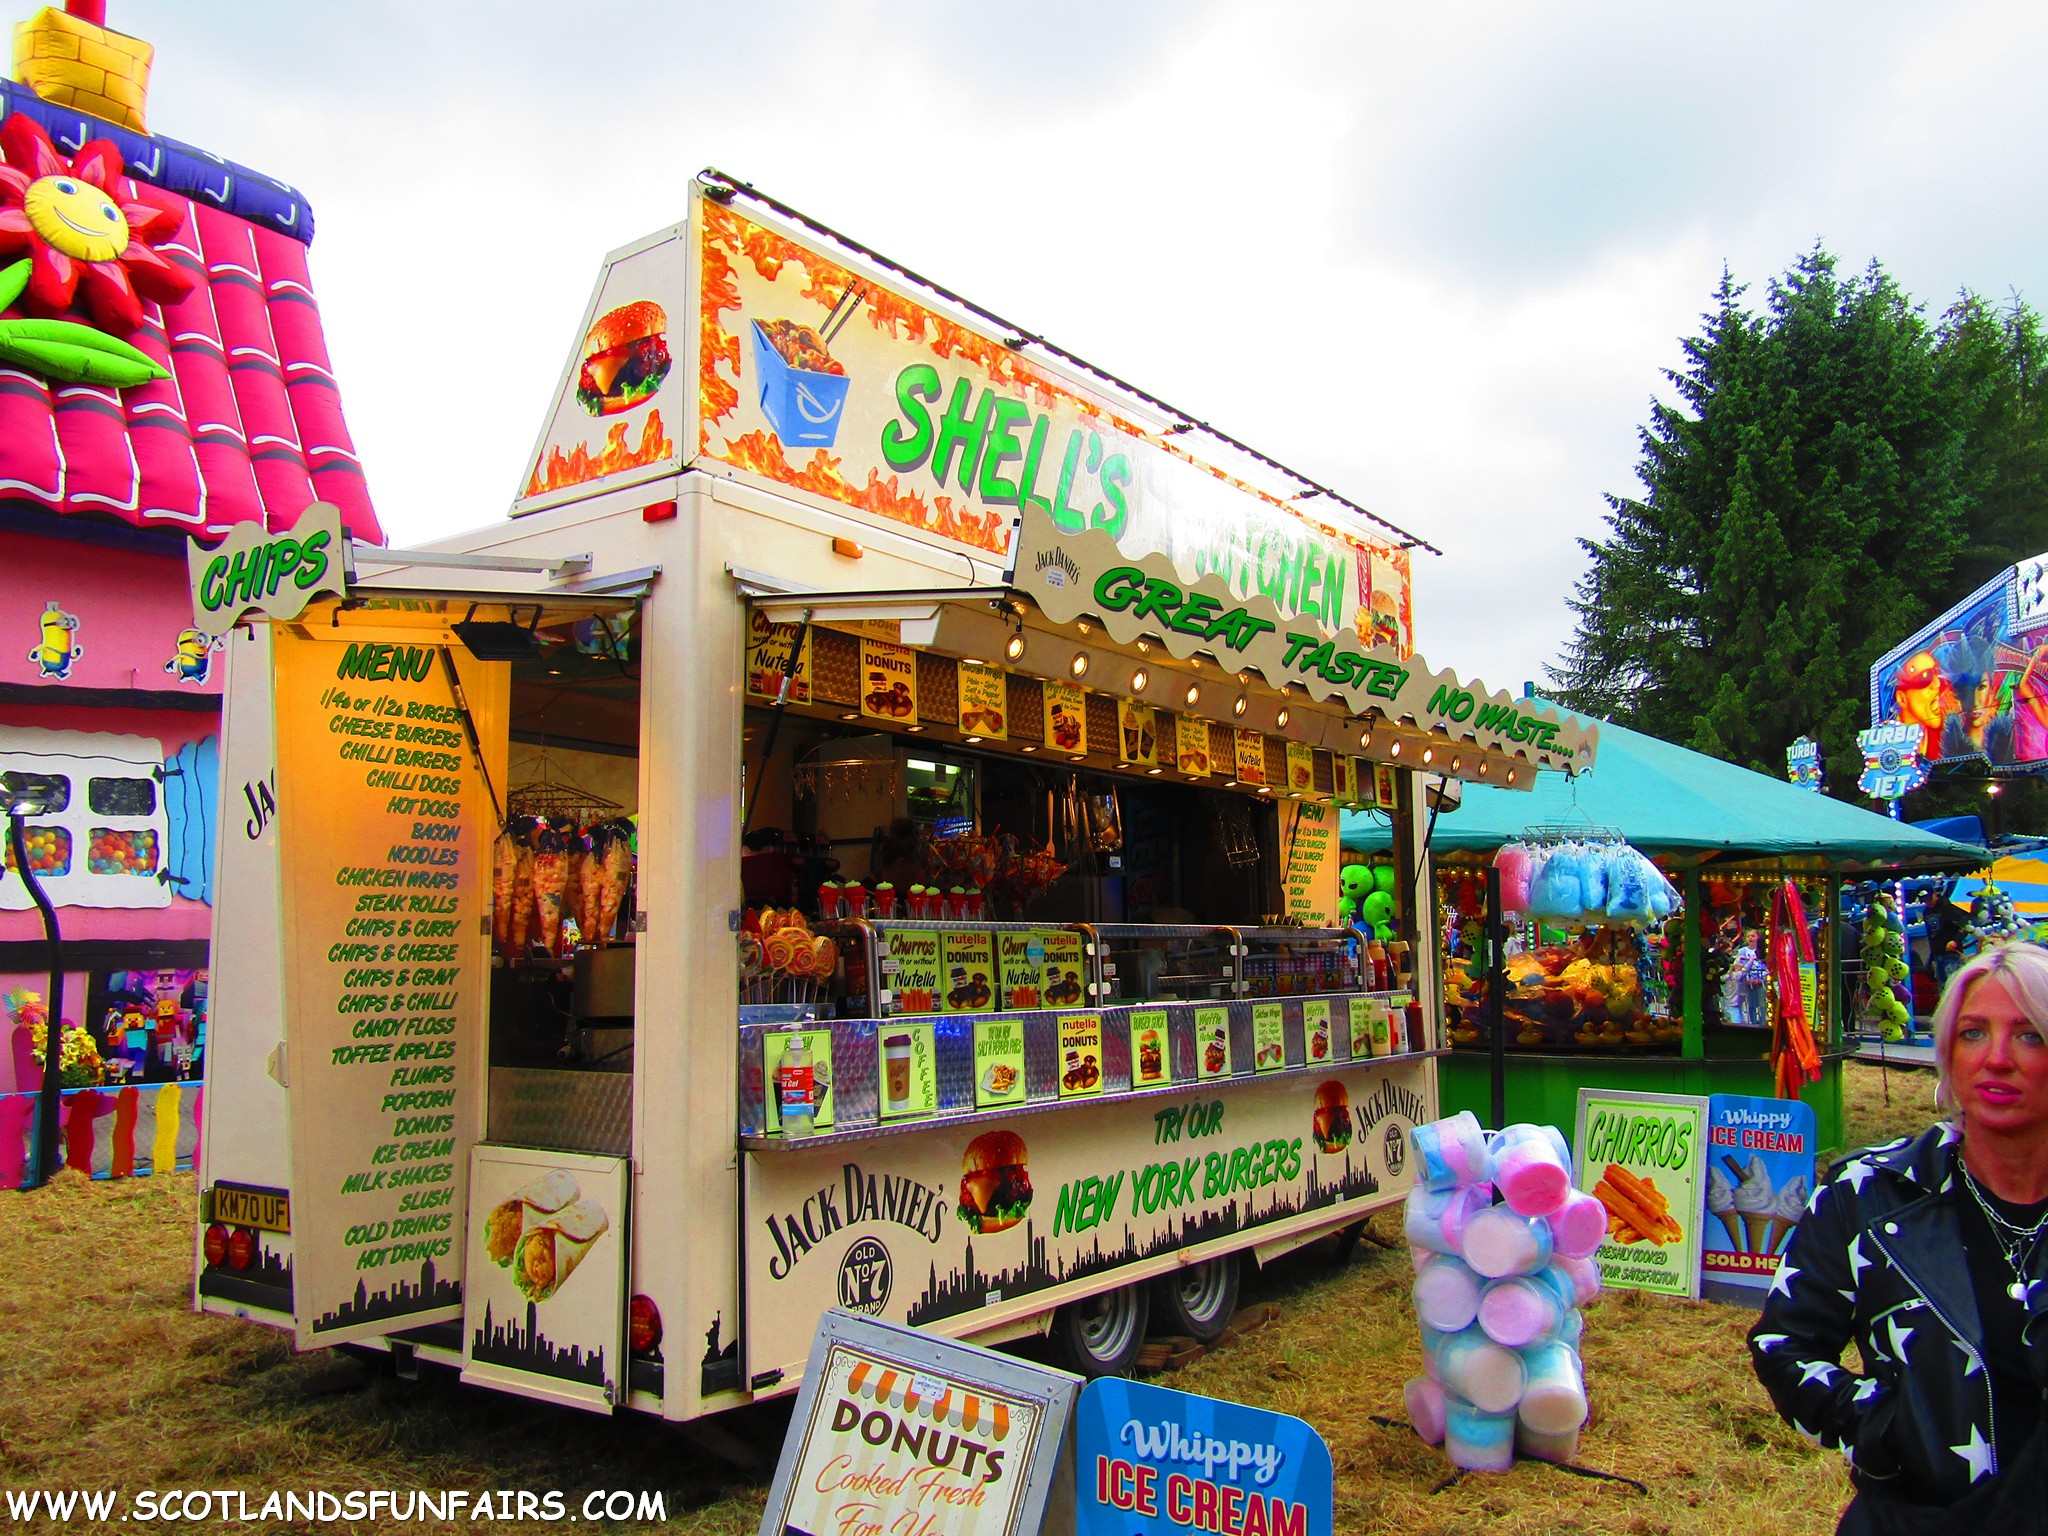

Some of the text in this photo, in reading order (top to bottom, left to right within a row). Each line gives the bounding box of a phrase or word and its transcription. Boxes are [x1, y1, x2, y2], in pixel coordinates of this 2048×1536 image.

[881, 363, 1132, 544] SHELL'S
[201, 530, 331, 611] CHIPS
[1036, 550, 1055, 572] JACK
[1055, 546, 1081, 585] DANIEL'S
[1093, 567, 1275, 653] GREAT
[1282, 632, 1410, 701] TASTE!
[1427, 684, 1475, 722] NO
[337, 643, 436, 682] MENU
[755, 648, 804, 674] Nutea
[865, 653, 912, 675] DONUTS
[354, 698, 371, 711] or
[406, 701, 464, 725] BURGER
[330, 715, 463, 748] CHEESE BURGERS
[1858, 724, 1921, 747] TURBO
[340, 741, 462, 771] CHILLI BURGERS
[1786, 742, 1818, 760] TURBO
[366, 769, 461, 795] CHILLI DOGS
[1869, 774, 1912, 800] JET
[243, 767, 276, 840] JA
[386, 796, 460, 819] HOT DOGS
[411, 822, 461, 842] BACON
[387, 845, 459, 866] NOODLES
[336, 867, 459, 890] CHICKEN WRAPS
[355, 894, 458, 914] STEAK ROLLS
[346, 918, 461, 937] CHIPS & CURRY
[947, 934, 987, 944] nutella
[890, 933, 936, 956] Churros
[1043, 935, 1078, 946] nutella
[328, 943, 459, 962] CHIPS & CHEESE
[914, 957, 936, 965] without
[946, 951, 988, 963] DONUTS
[1043, 951, 1080, 963] DONUTS
[343, 968, 460, 987] CHIPS & GRAVY
[894, 969, 936, 988] Nutella
[1006, 968, 1040, 986] Nutella
[338, 992, 459, 1013] CHIPS & CHILLI
[352, 1017, 457, 1038] CANDY FLOSS
[1063, 1019, 1097, 1030] nutella
[1063, 1035, 1098, 1047] DONUTS
[332, 1041, 456, 1065] TOFFEE APPLES
[390, 1065, 456, 1086] FLUMPS
[912, 1028, 933, 1108] COFFEE
[381, 1089, 457, 1112] POPCORN
[393, 1114, 455, 1137] DONUTS
[1154, 1100, 1224, 1146] TRY OUR
[1356, 1089, 1384, 1144] JACK
[1720, 1108, 1794, 1130] Whippy
[371, 1137, 456, 1164] ICE CREAM
[1589, 1111, 1692, 1171] CHURROS
[1710, 1126, 1805, 1153] ICE CREAM
[341, 1163, 453, 1194] MILK SHAKES
[1053, 1137, 1303, 1238] NEW YORK BURGERS
[220, 1190, 290, 1228] KM70 UF
[398, 1186, 455, 1212] SLUSH
[344, 1213, 453, 1246] COLD DRINKS
[765, 1163, 948, 1280] JACK DANIEL'S
[356, 1237, 452, 1270] HOT DRINKS
[855, 1246, 876, 1260] OLD
[1594, 1244, 1668, 1267] FRESHLY COOKED
[1705, 1252, 1780, 1271] SOLD HE
[1620, 1266, 1680, 1287] SATISFACTION
[831, 1399, 1006, 1483] DONUTS
[1120, 1419, 1286, 1487] Whippy
[815, 1454, 987, 1508] Cooked Fresh
[1096, 1454, 1309, 1536] ICE CREAM
[834, 1502, 883, 1536] For
